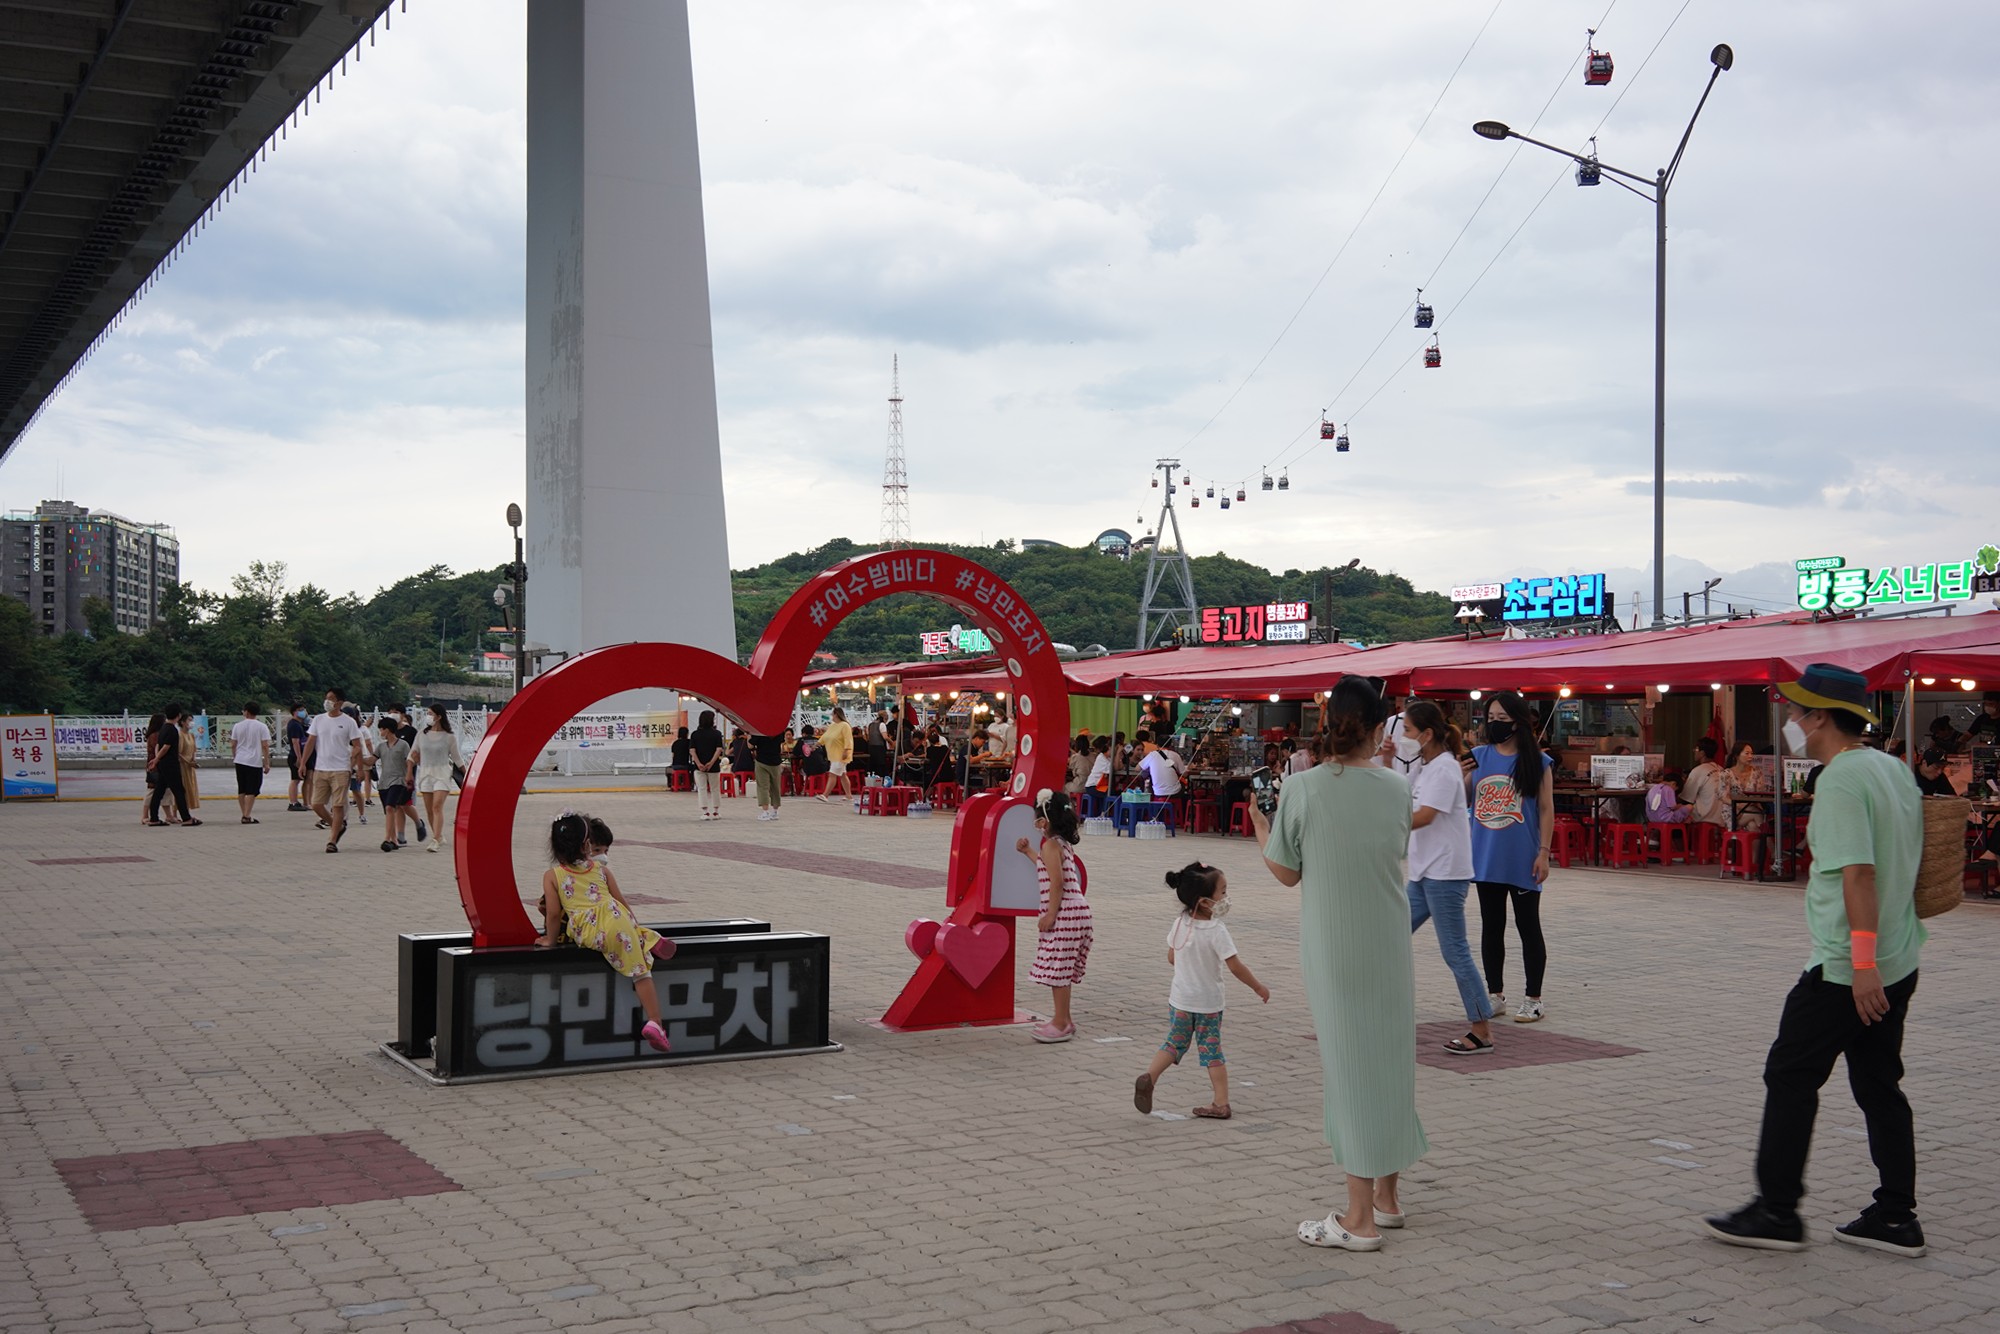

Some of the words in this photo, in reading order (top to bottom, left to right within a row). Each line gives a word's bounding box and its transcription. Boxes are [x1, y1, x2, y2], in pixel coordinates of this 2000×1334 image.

[1453, 586, 1498, 599] 여수자랑포차
[1502, 573, 1605, 621] 초도삼리
[1798, 560, 1976, 611] 방풍소년단
[808, 557, 937, 628] #여수밤바다
[954, 568, 1046, 657] #낭만포차
[1266, 603, 1307, 621] 명품포차
[1201, 605, 1265, 643] 동고지
[919, 631, 949, 656] 거문도
[6, 728, 48, 744] 마스크
[100, 727, 133, 744] 국제행사
[569, 726, 584, 740] 위해
[585, 725, 615, 739] 마스크를
[615, 723, 627, 736] 꼭
[628, 724, 650, 738] 착용해
[1480, 783, 1517, 807] Belly
[473, 961, 798, 1068] 낭만포차
